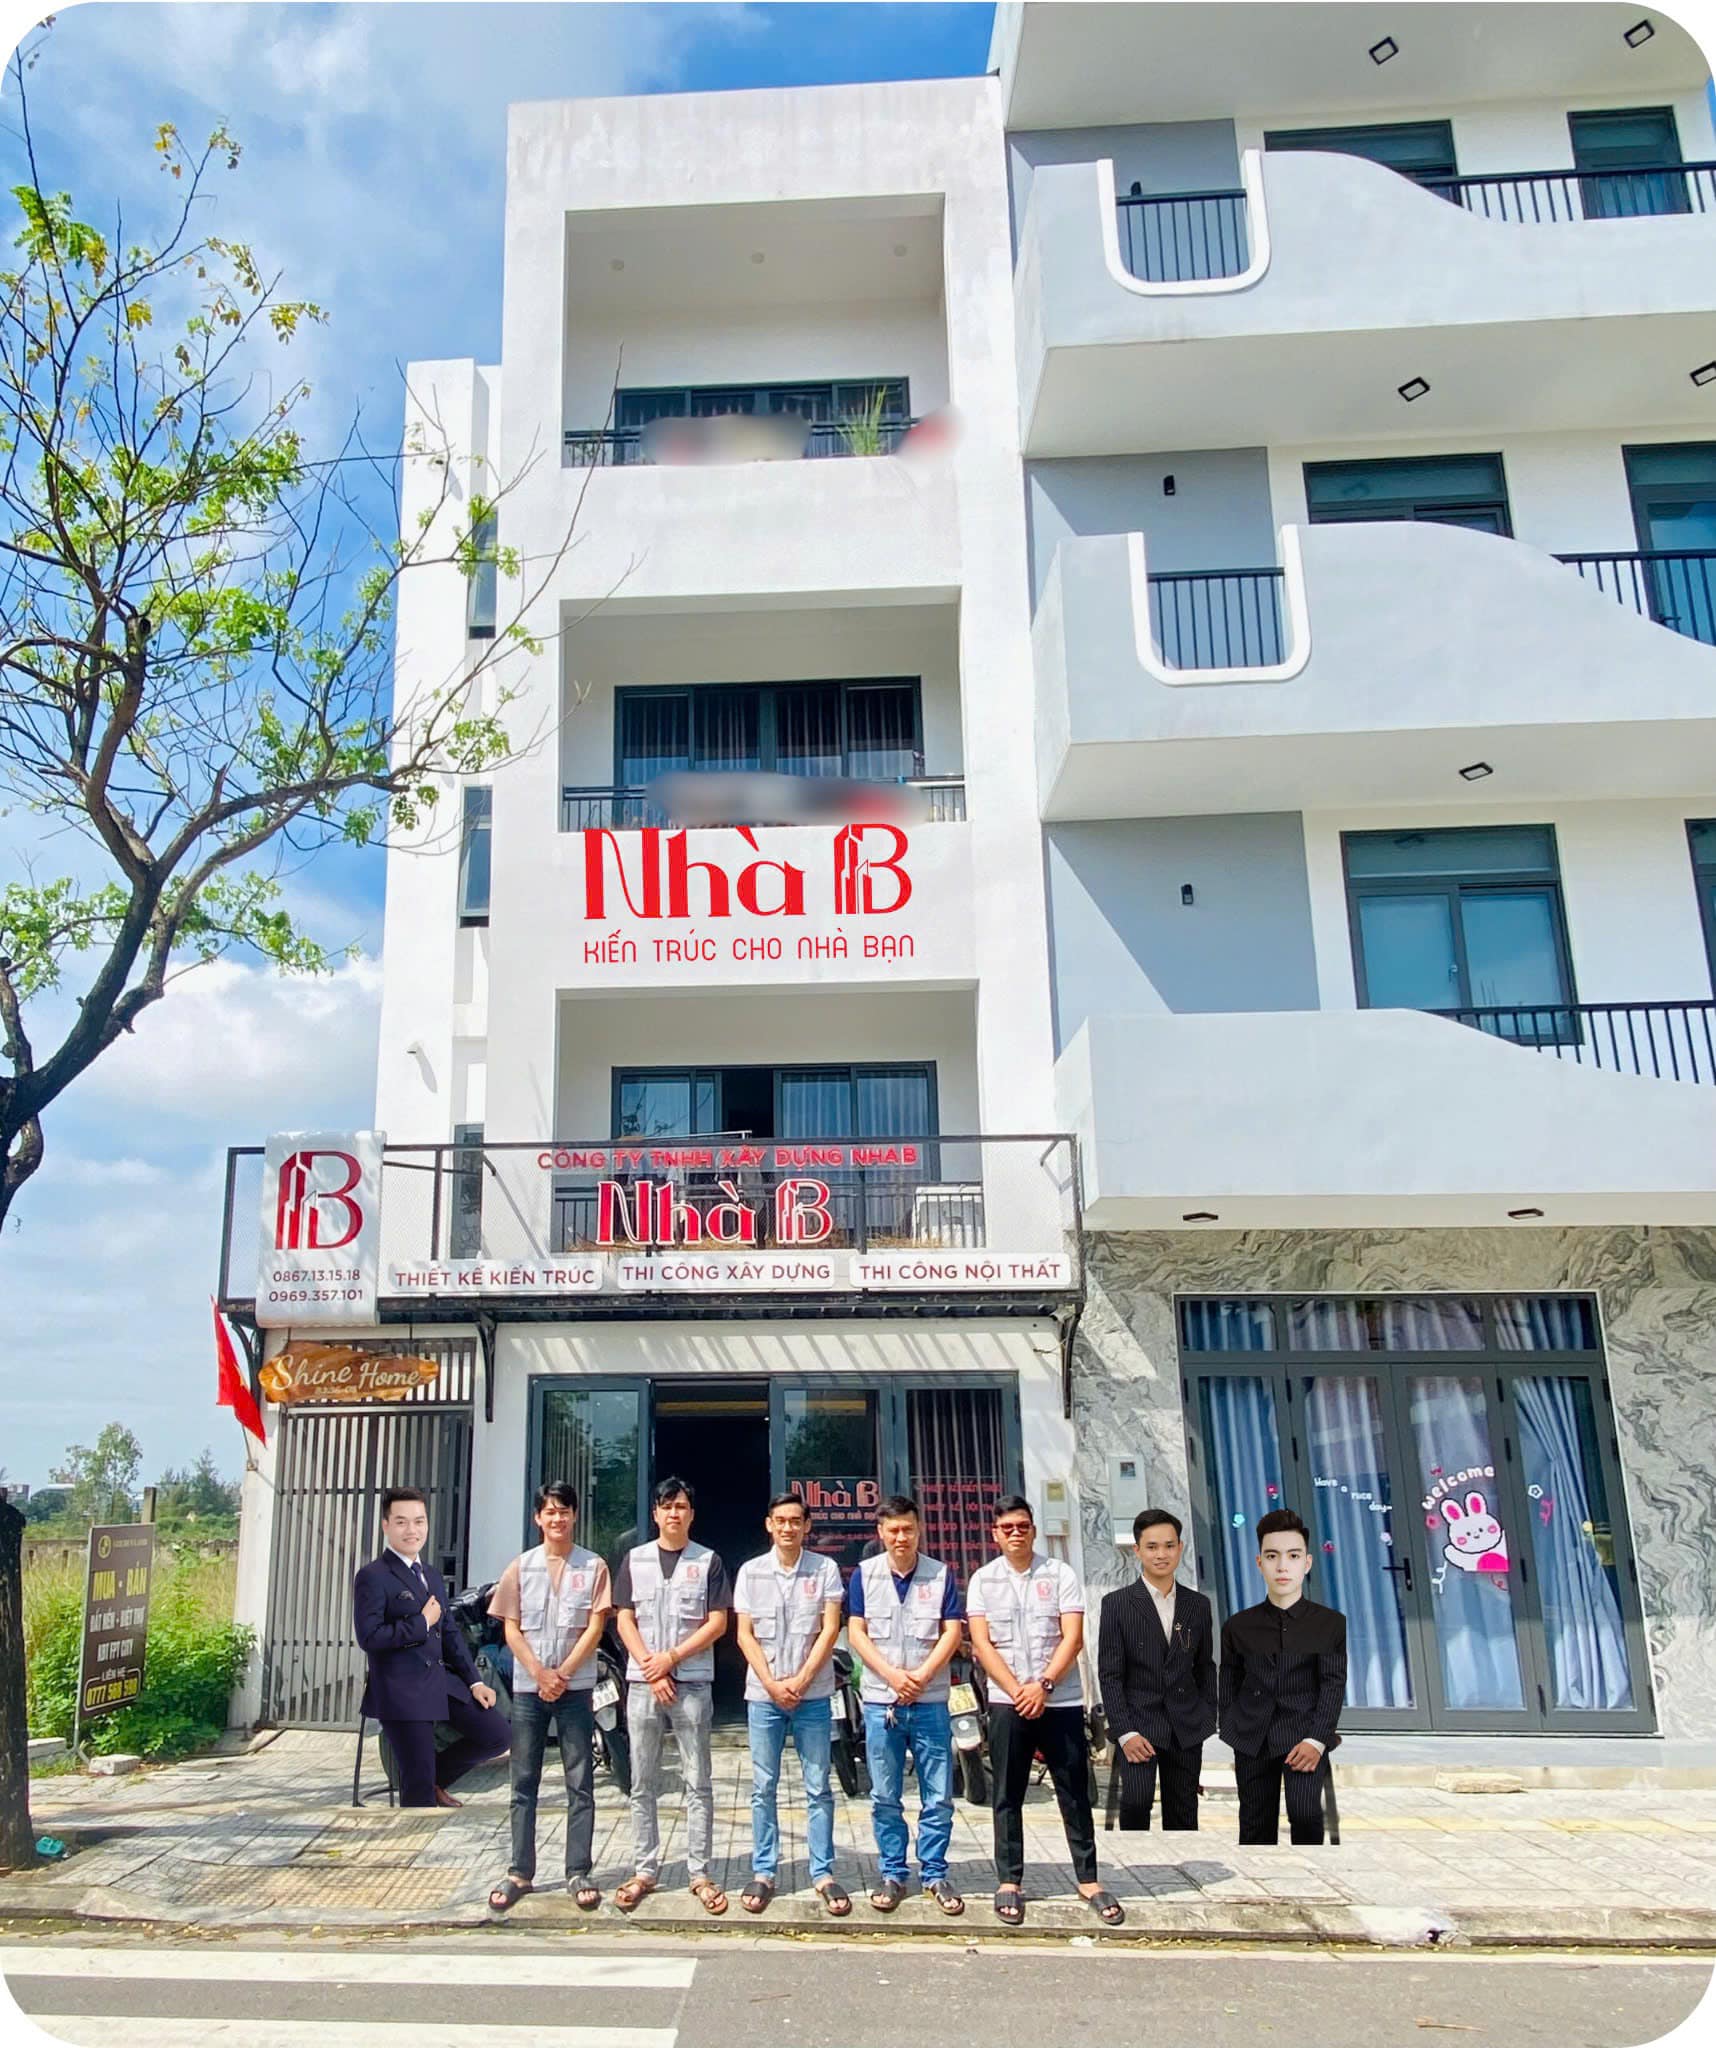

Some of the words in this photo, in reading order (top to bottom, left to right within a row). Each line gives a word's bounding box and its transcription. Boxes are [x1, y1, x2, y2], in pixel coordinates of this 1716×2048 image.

[583, 826, 806, 920] Nhà
[833, 823, 912, 915] B
[584, 930, 637, 964] KIẾN
[653, 929, 716, 962] TRÚC
[732, 936, 783, 961] CHO
[798, 928, 848, 960] NHÀ
[864, 935, 914, 964] BẠN
[537, 1146, 607, 1169] CÔNG
[614, 1150, 643, 1170] TY
[651, 1150, 713, 1169] TNHH
[719, 1145, 767, 1168] XÂY
[775, 1147, 843, 1171] DỰNG
[275, 1151, 364, 1250] B
[596, 1180, 756, 1245] Nhà
[776, 1178, 833, 1244] B
[273, 1269, 360, 1283] 0867.13.15.18
[395, 1265, 451, 1287] THIẾT
[458, 1264, 484, 1286] KẾ
[490, 1264, 535, 1285] KIẾN
[542, 1265, 594, 1285] TRÚC
[623, 1265, 654, 1281] THI
[661, 1261, 720, 1280] CÔNG
[727, 1261, 765, 1280] XÂY
[772, 1263, 831, 1283] DỰNG
[859, 1265, 891, 1280] THI
[899, 1260, 958, 1280] CÔNG
[965, 1260, 1001, 1283] NỘI
[1008, 1257, 1061, 1280] THẤT
[269, 1289, 363, 1302] 0969.357.101
[272, 1354, 353, 1390] Shine
[358, 1361, 421, 1390] Home
[791, 1480, 852, 1508] Nhà
[857, 1480, 881, 1507] B
[1341, 1485, 1348, 1493] a
[1421, 1465, 1495, 1510] welcome
